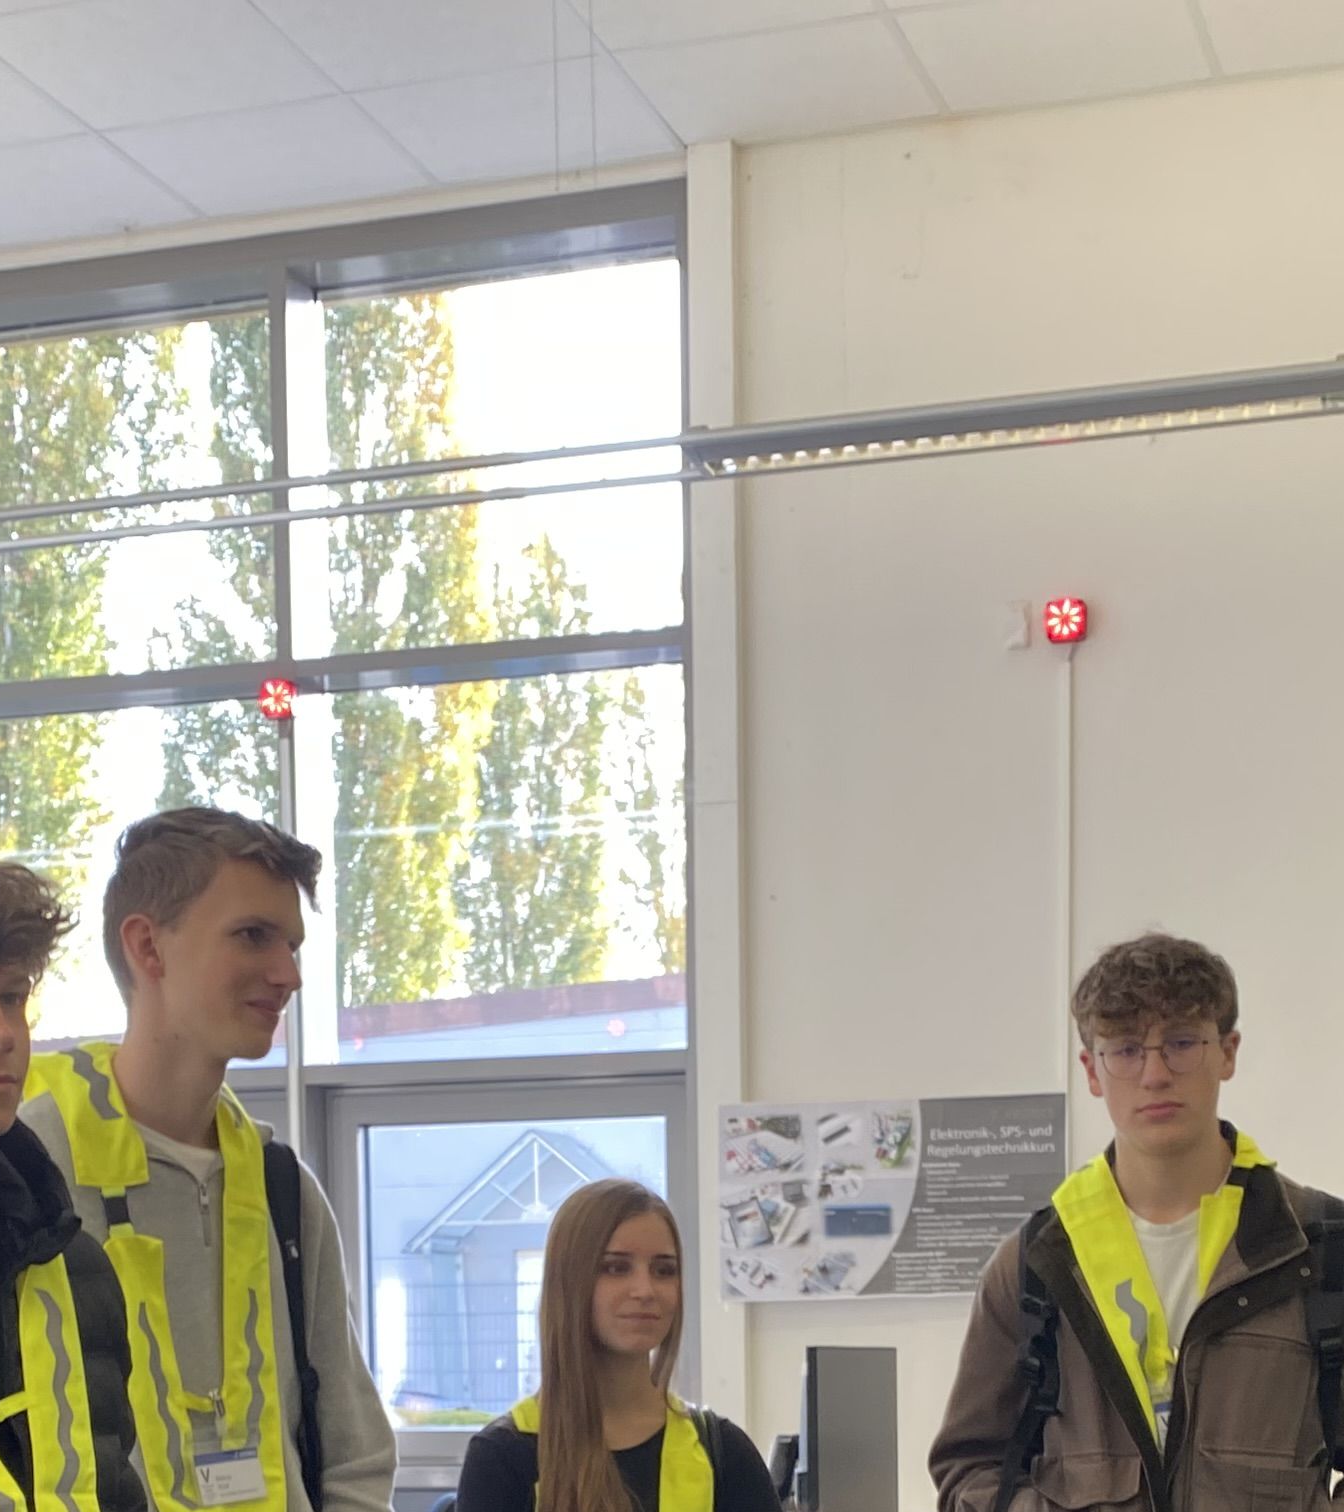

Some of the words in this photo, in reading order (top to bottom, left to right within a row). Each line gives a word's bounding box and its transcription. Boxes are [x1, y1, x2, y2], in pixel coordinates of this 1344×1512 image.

[929, 1126, 997, 1141] Elektronik-,
[999, 1124, 1027, 1139] SPS-
[1028, 1123, 1054, 1137] und
[926, 1142, 1056, 1158] Regelungstechnikkurs
[200, 1467, 210, 1483] V
